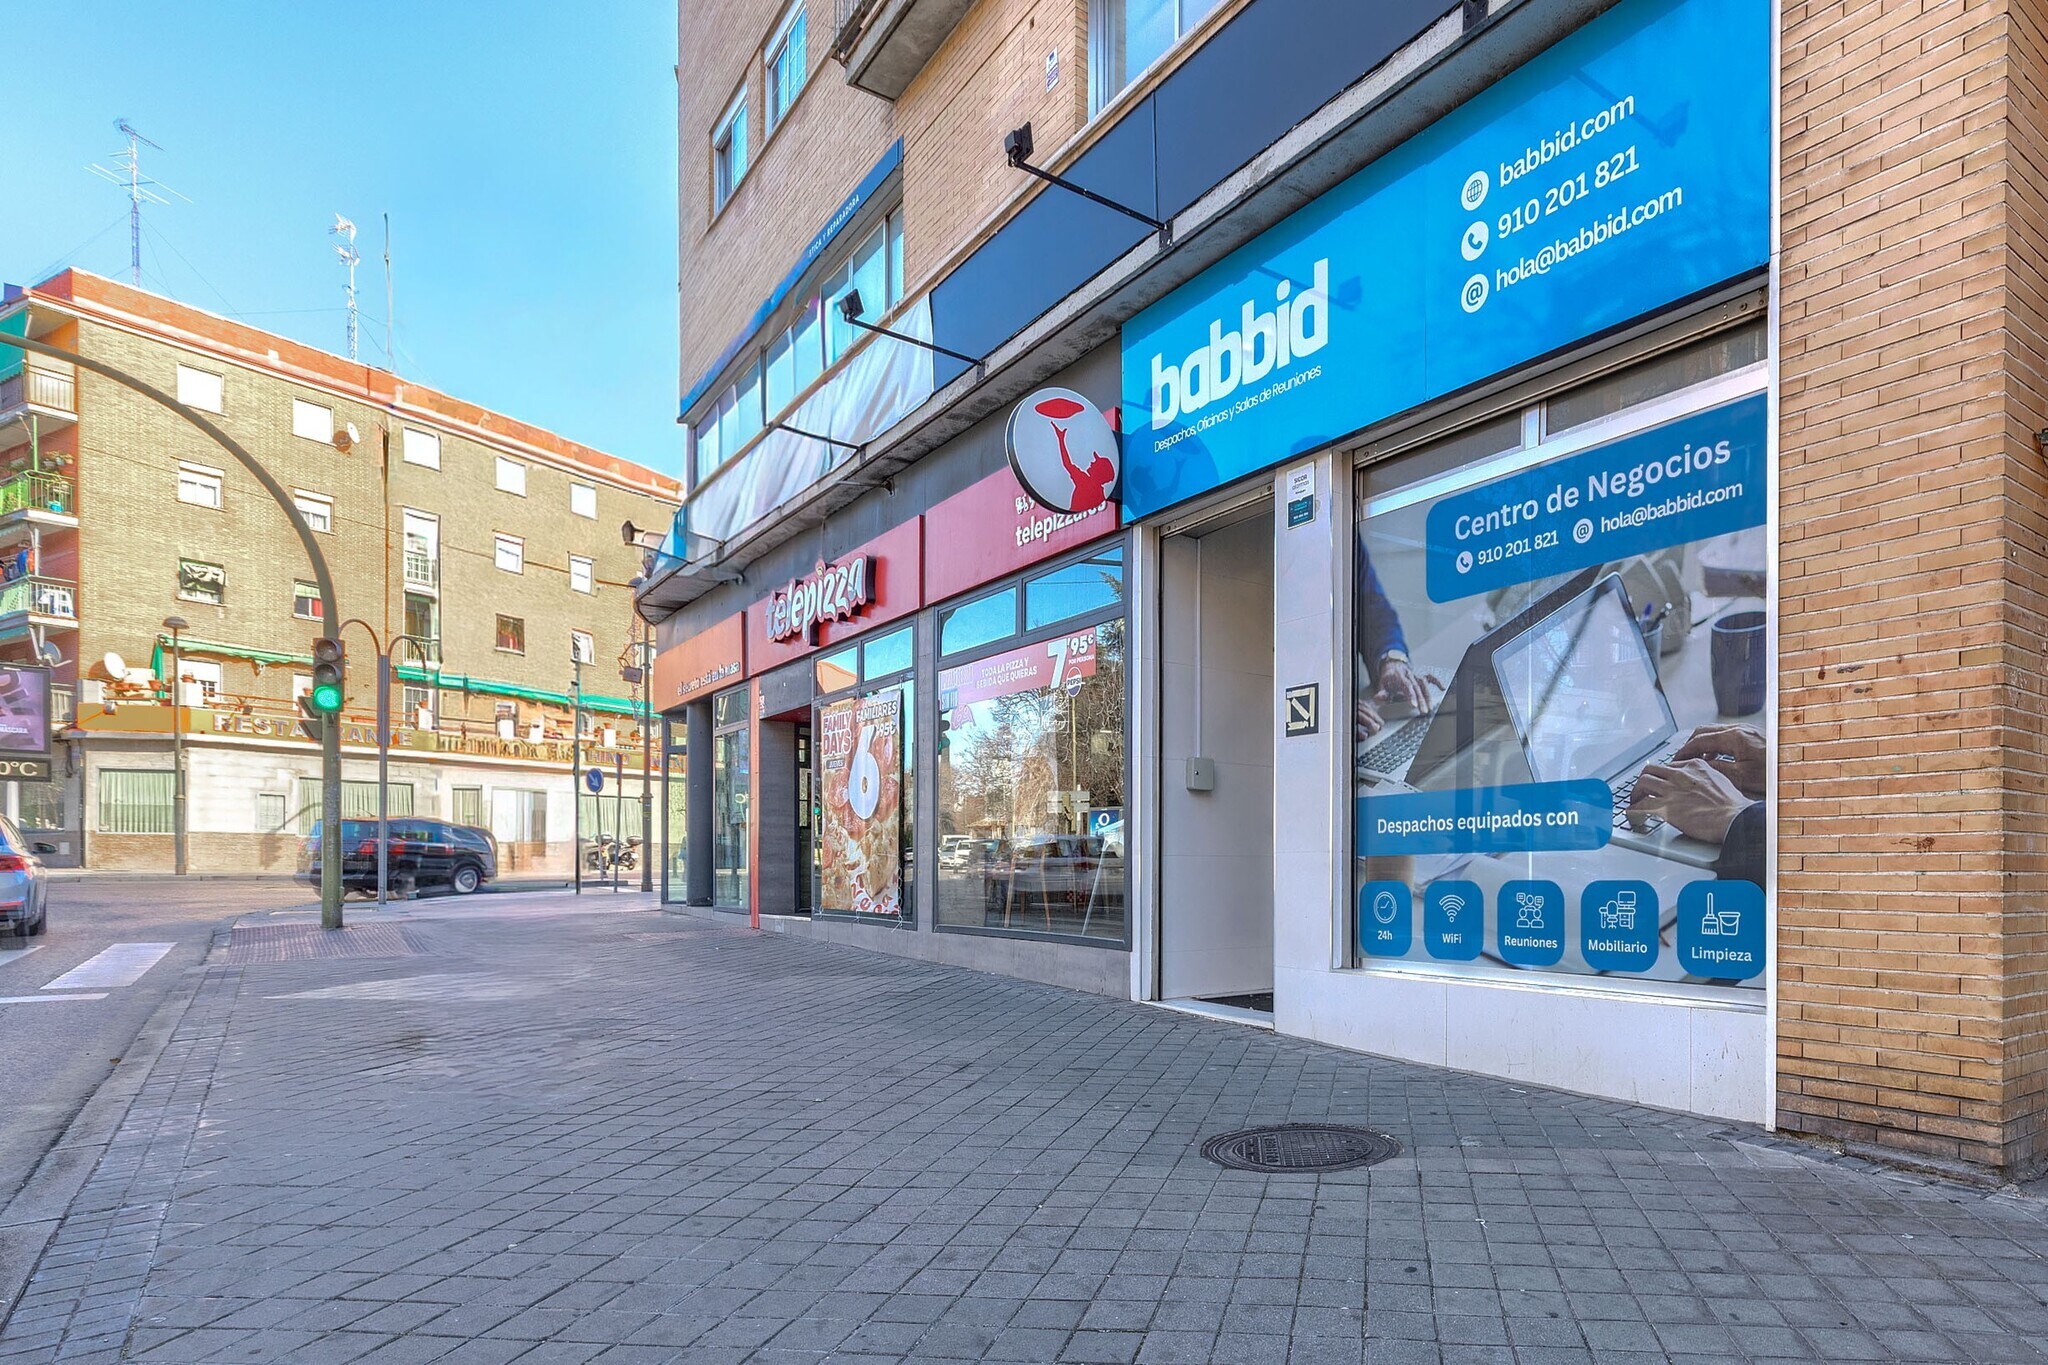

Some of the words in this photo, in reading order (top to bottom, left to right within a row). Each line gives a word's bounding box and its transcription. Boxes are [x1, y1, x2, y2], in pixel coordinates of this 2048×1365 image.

[1500, 95, 1635, 188] babbid.com
[1498, 199, 1540, 239] 910
[1545, 172, 1589, 216] 201
[1595, 145, 1640, 188] 821
[1496, 187, 1683, 291] hola@babbid.com
[1151, 257, 1329, 430] babbid
[1196, 408, 1229, 432] Oficinas
[1229, 407, 1235, 421] y
[1235, 394, 1259, 414] Salas
[1260, 388, 1272, 403] de
[1272, 365, 1322, 396] Reuniones
[1455, 499, 1539, 540] Centro
[1546, 485, 1579, 513] de
[1588, 439, 1731, 501] Negocios
[1478, 545, 1502, 565] 910
[1505, 539, 1531, 558] 201
[1534, 530, 1559, 550] 821
[1601, 482, 1743, 533] hola@babbid.com
[766, 556, 866, 642] telepizza
[981, 665, 997, 678] TODA
[997, 663, 1005, 674] LA
[1005, 660, 1023, 672] PIZZA
[1024, 657, 1029, 666] Y
[997, 673, 1009, 685] QUE
[1009, 665, 1038, 681] QUIERAS
[823, 710, 852, 733] FAMILY
[856, 700, 897, 722] FAMILIARES
[213, 713, 413, 746] RESTARANE
[823, 730, 851, 755] DAYS
[1377, 815, 1454, 841] Despachos
[1457, 811, 1542, 840] equipados
[1546, 811, 1579, 827] con
[1377, 930, 1393, 941] 24h
[1441, 932, 1462, 945] WiFi
[1504, 935, 1558, 949] Reuniones
[1588, 938, 1648, 954] Mobiliario
[1691, 946, 1752, 964] Limpieza
